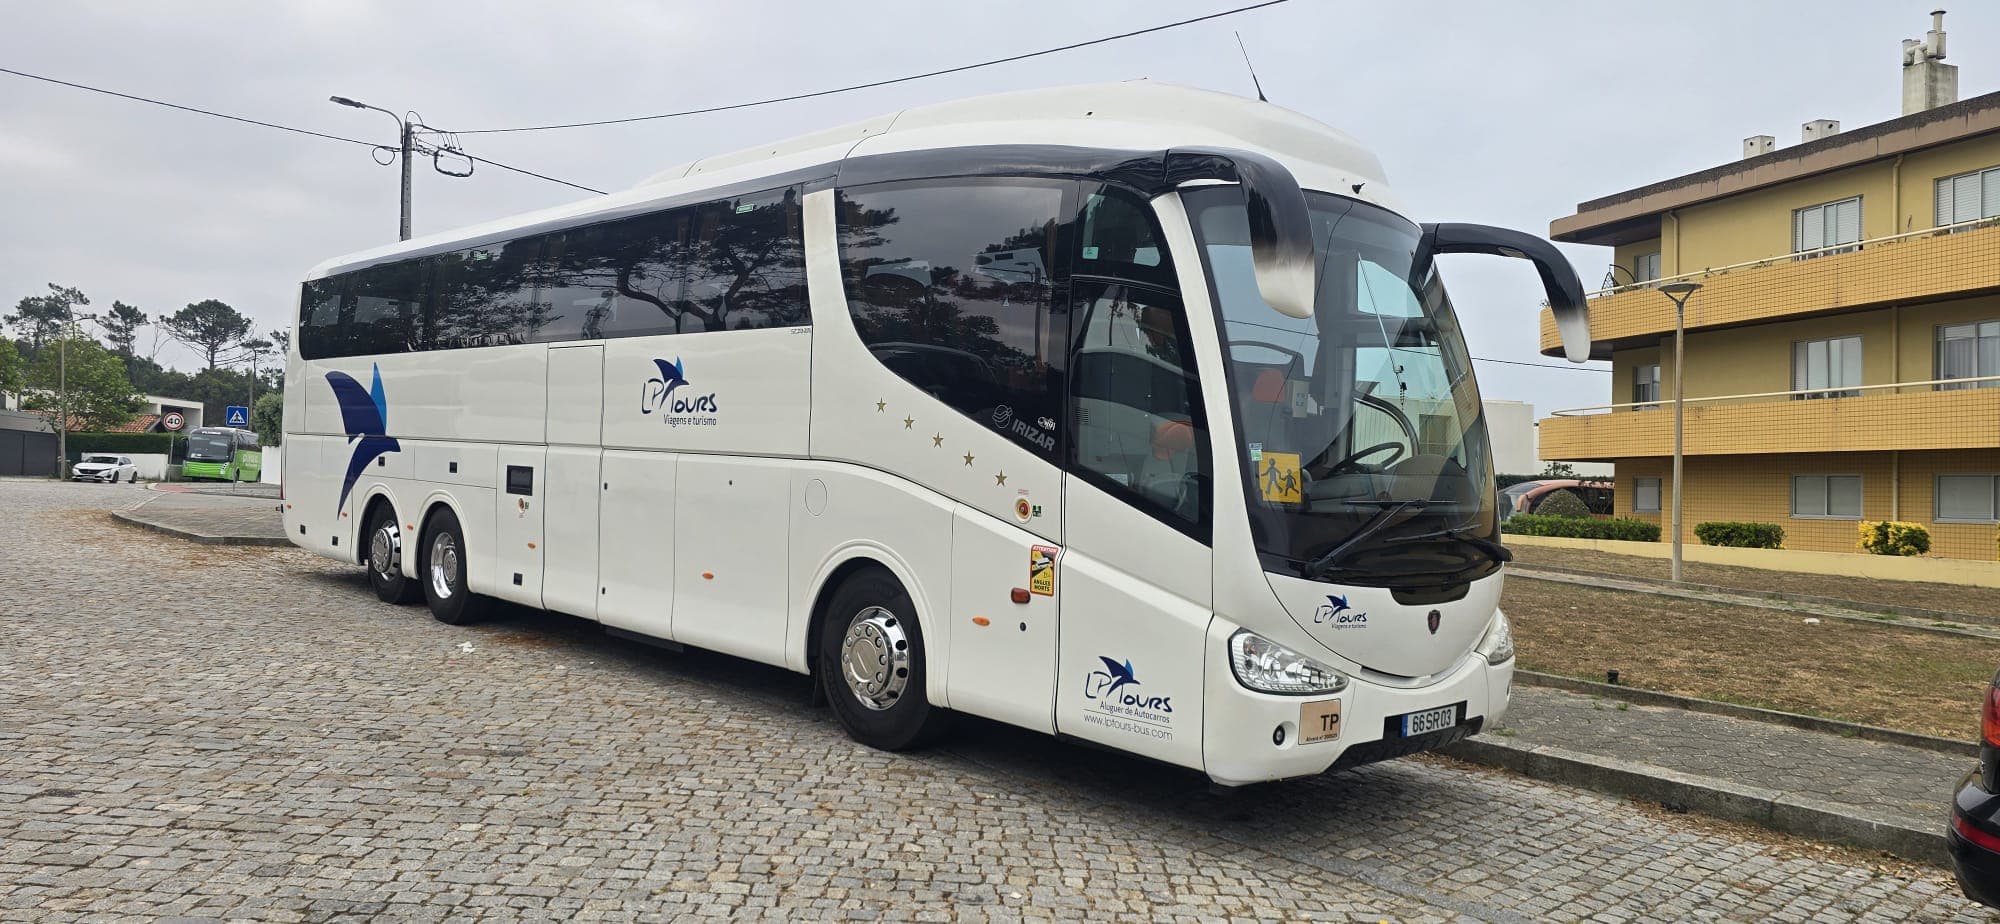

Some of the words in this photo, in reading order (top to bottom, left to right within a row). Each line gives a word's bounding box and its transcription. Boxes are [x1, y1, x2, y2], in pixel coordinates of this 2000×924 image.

[664, 414, 687, 427] Viagens
[688, 418, 692, 426] e
[693, 416, 717, 426] turismo
[1011, 419, 1056, 451] IRIZAR
[1033, 579, 1051, 587] ANGLES
[1034, 584, 1050, 592] MORTS
[1100, 701, 1124, 714] Aluguer
[1125, 707, 1133, 716] de
[1134, 708, 1170, 724] Autocarros
[1083, 713, 1173, 741] www.lptours-bus.com
[1320, 713, 1340, 731] TP
